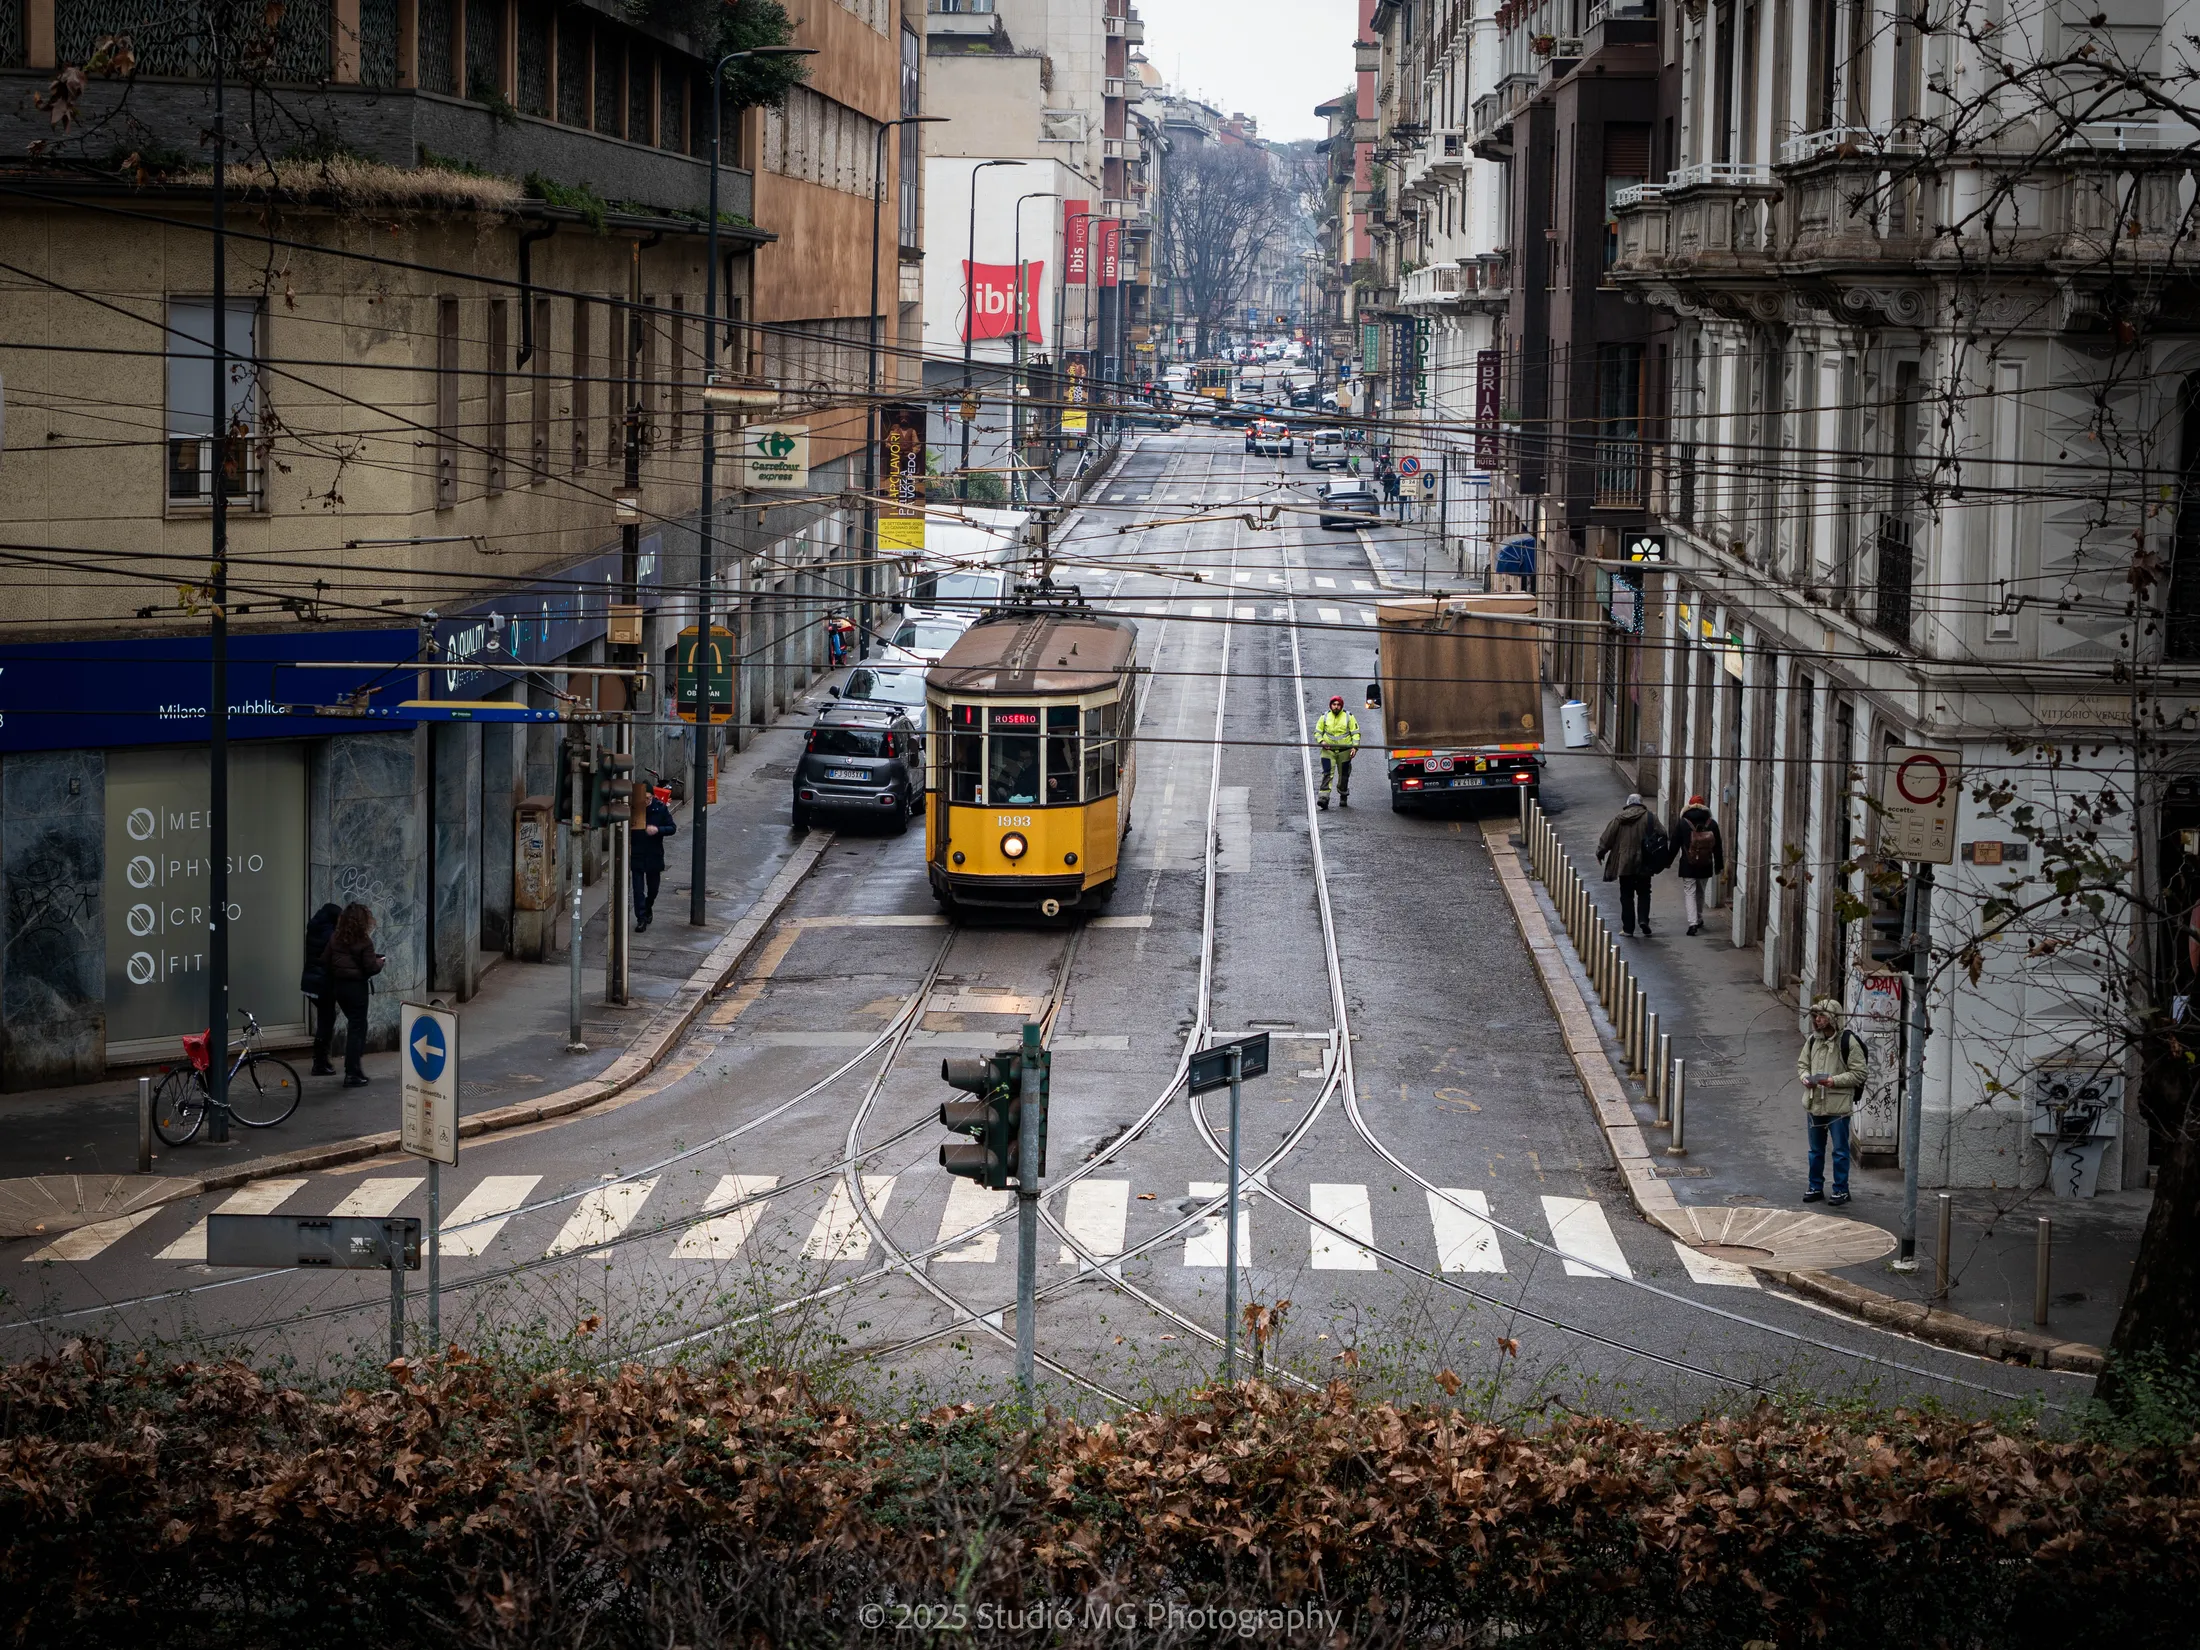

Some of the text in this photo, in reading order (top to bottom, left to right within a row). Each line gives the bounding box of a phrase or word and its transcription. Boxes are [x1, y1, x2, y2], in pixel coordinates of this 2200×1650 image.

[1070, 247, 1084, 272] ibis
[1480, 366, 1495, 455] BRIANZA
[752, 461, 800, 470] Carrefour
[1476, 457, 1496, 465] HOTEL
[758, 473, 793, 482] express
[459, 623, 486, 663] QUALITY
[160, 703, 206, 719] Milano
[2041, 710, 2090, 719] VITTORIO
[995, 714, 1036, 723] ROSERIO
[998, 815, 1031, 827] 1993
[170, 903, 241, 925] CRO
[170, 953, 202, 973] FIT
